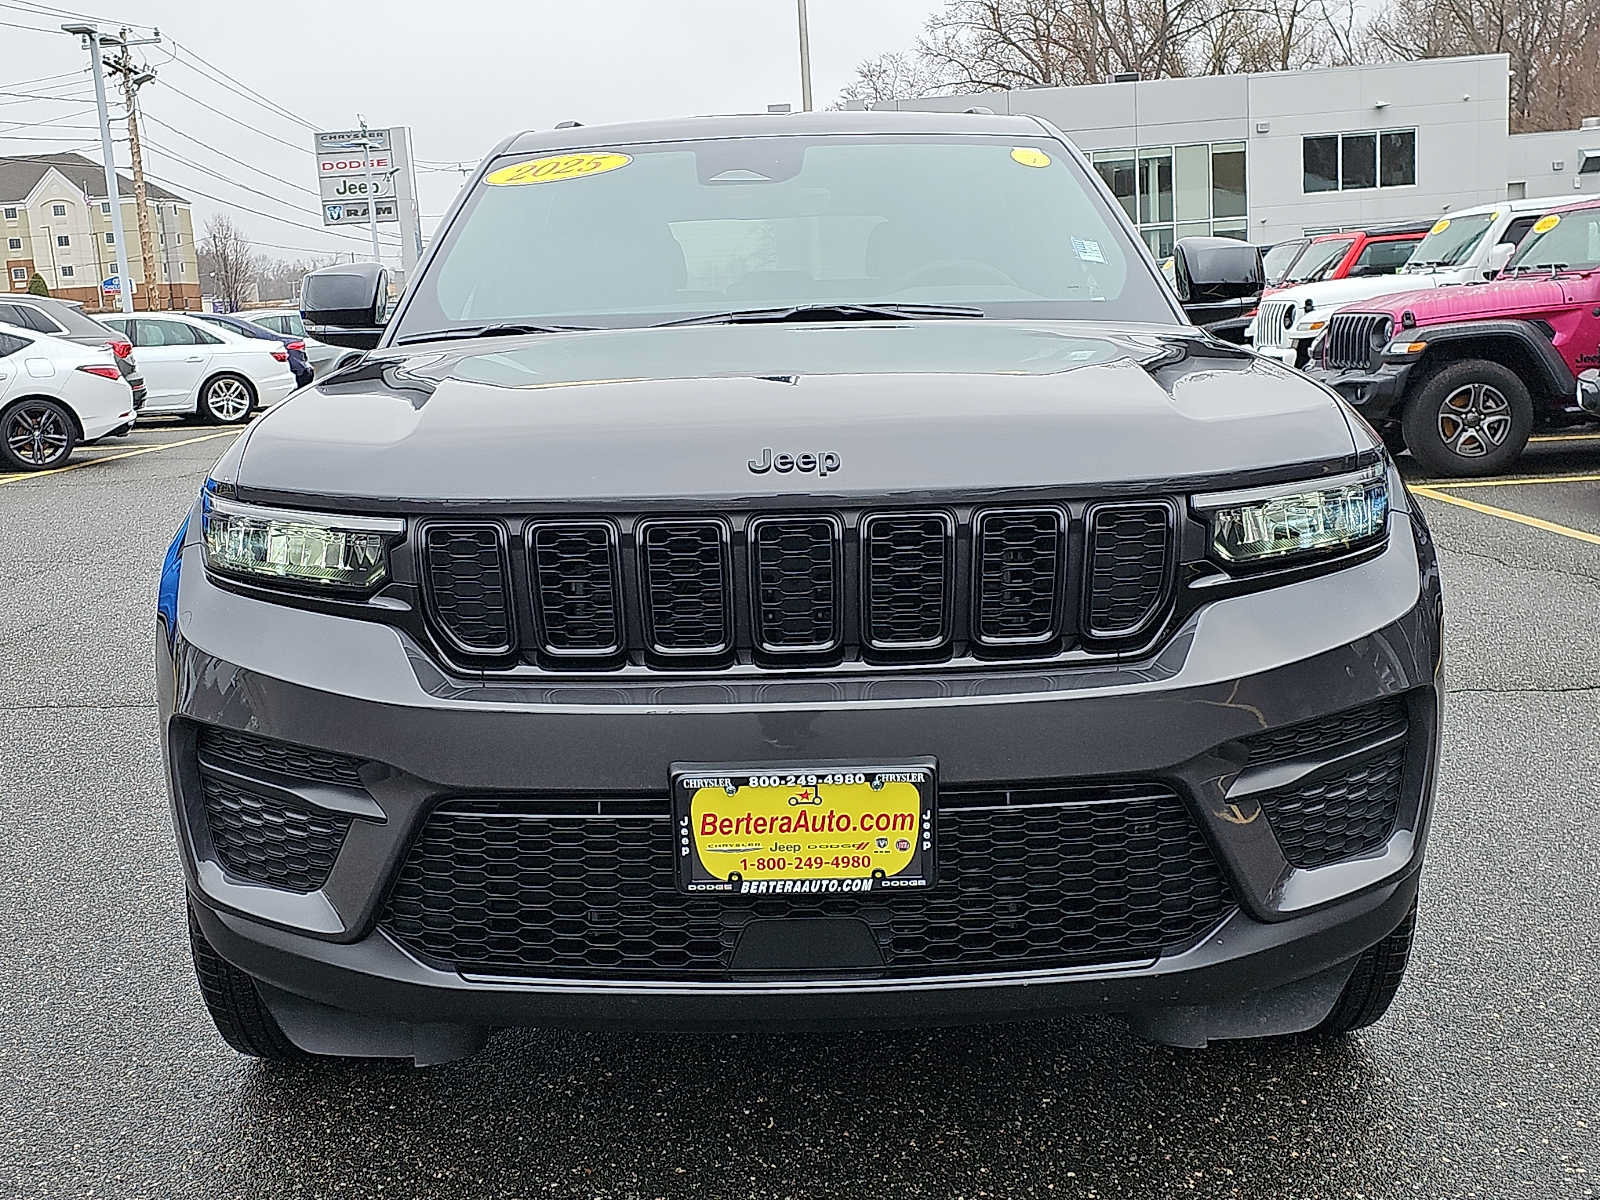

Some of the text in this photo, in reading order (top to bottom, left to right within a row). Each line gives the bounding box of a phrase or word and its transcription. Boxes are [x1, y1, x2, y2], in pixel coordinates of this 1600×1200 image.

[505, 156, 612, 181] 2025
[747, 448, 841, 477] Jeep
[683, 778, 732, 788] CHRYSLER
[748, 774, 866, 788] 800-249-4980
[875, 773, 925, 783] CHRYSLER
[700, 809, 914, 836] BerteraAuto.com
[922, 810, 932, 851] Jeep
[680, 816, 690, 856] Jeep
[769, 842, 801, 853] Jeep
[740, 855, 871, 871] 1-800-249-4980
[740, 879, 874, 894] BERTERAAUTO.COM
